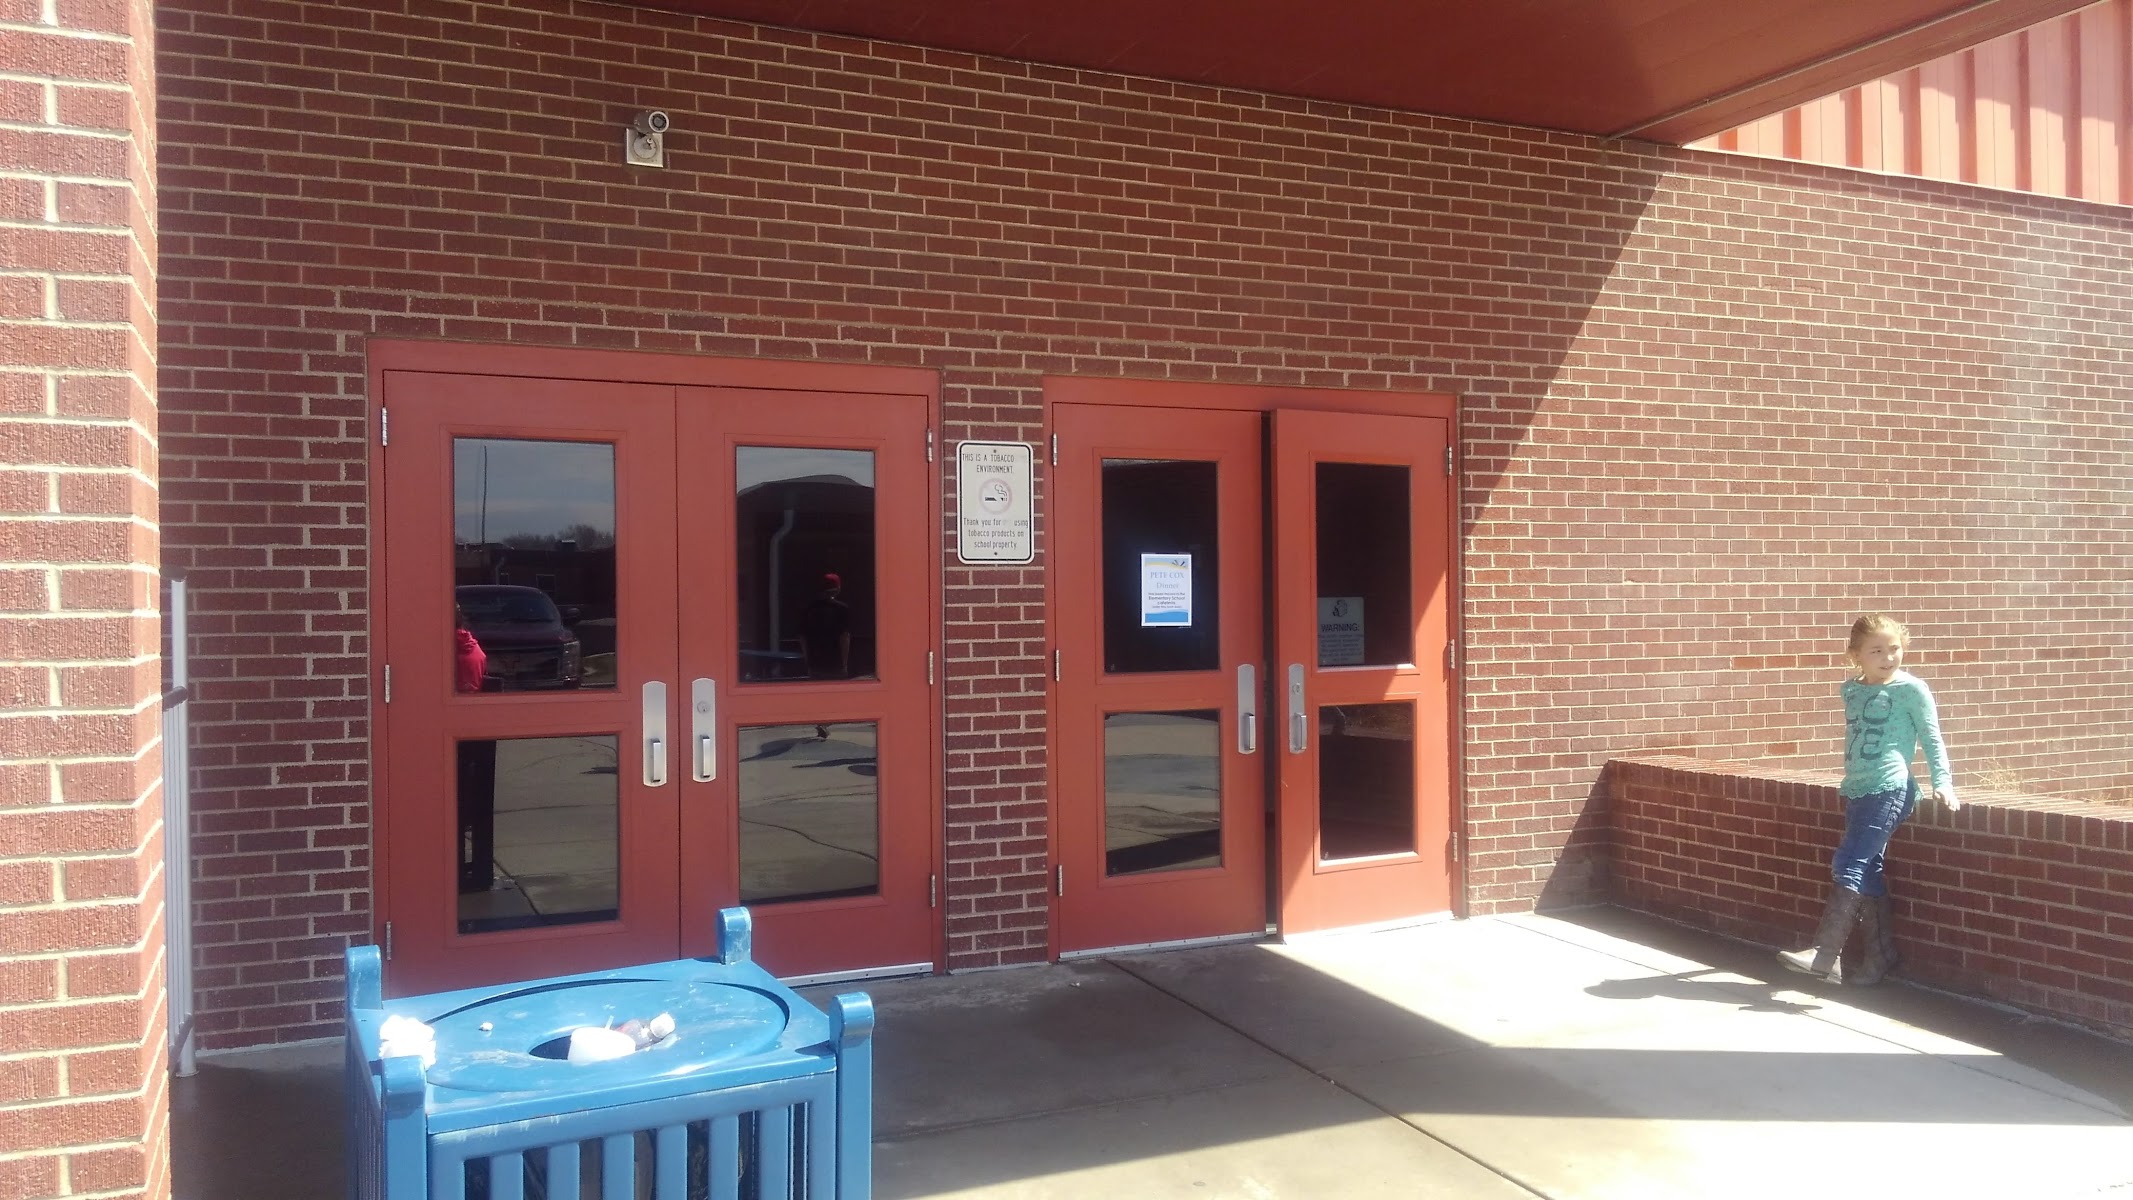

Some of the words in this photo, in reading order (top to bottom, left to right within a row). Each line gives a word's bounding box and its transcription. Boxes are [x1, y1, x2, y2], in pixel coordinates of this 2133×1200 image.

[962, 453, 974, 462] THIS
[975, 453, 981, 462] IS
[983, 454, 988, 462] A
[990, 454, 1015, 463] TOBACCO
[963, 517, 979, 526] Thank
[981, 519, 992, 527] you
[993, 518, 1002, 526] for
[1014, 519, 1029, 528] using
[968, 529, 990, 537] tobacco
[991, 530, 1016, 538] products
[974, 540, 992, 548] school
[1150, 571, 1167, 579] PETE
[1169, 571, 1185, 579] COX
